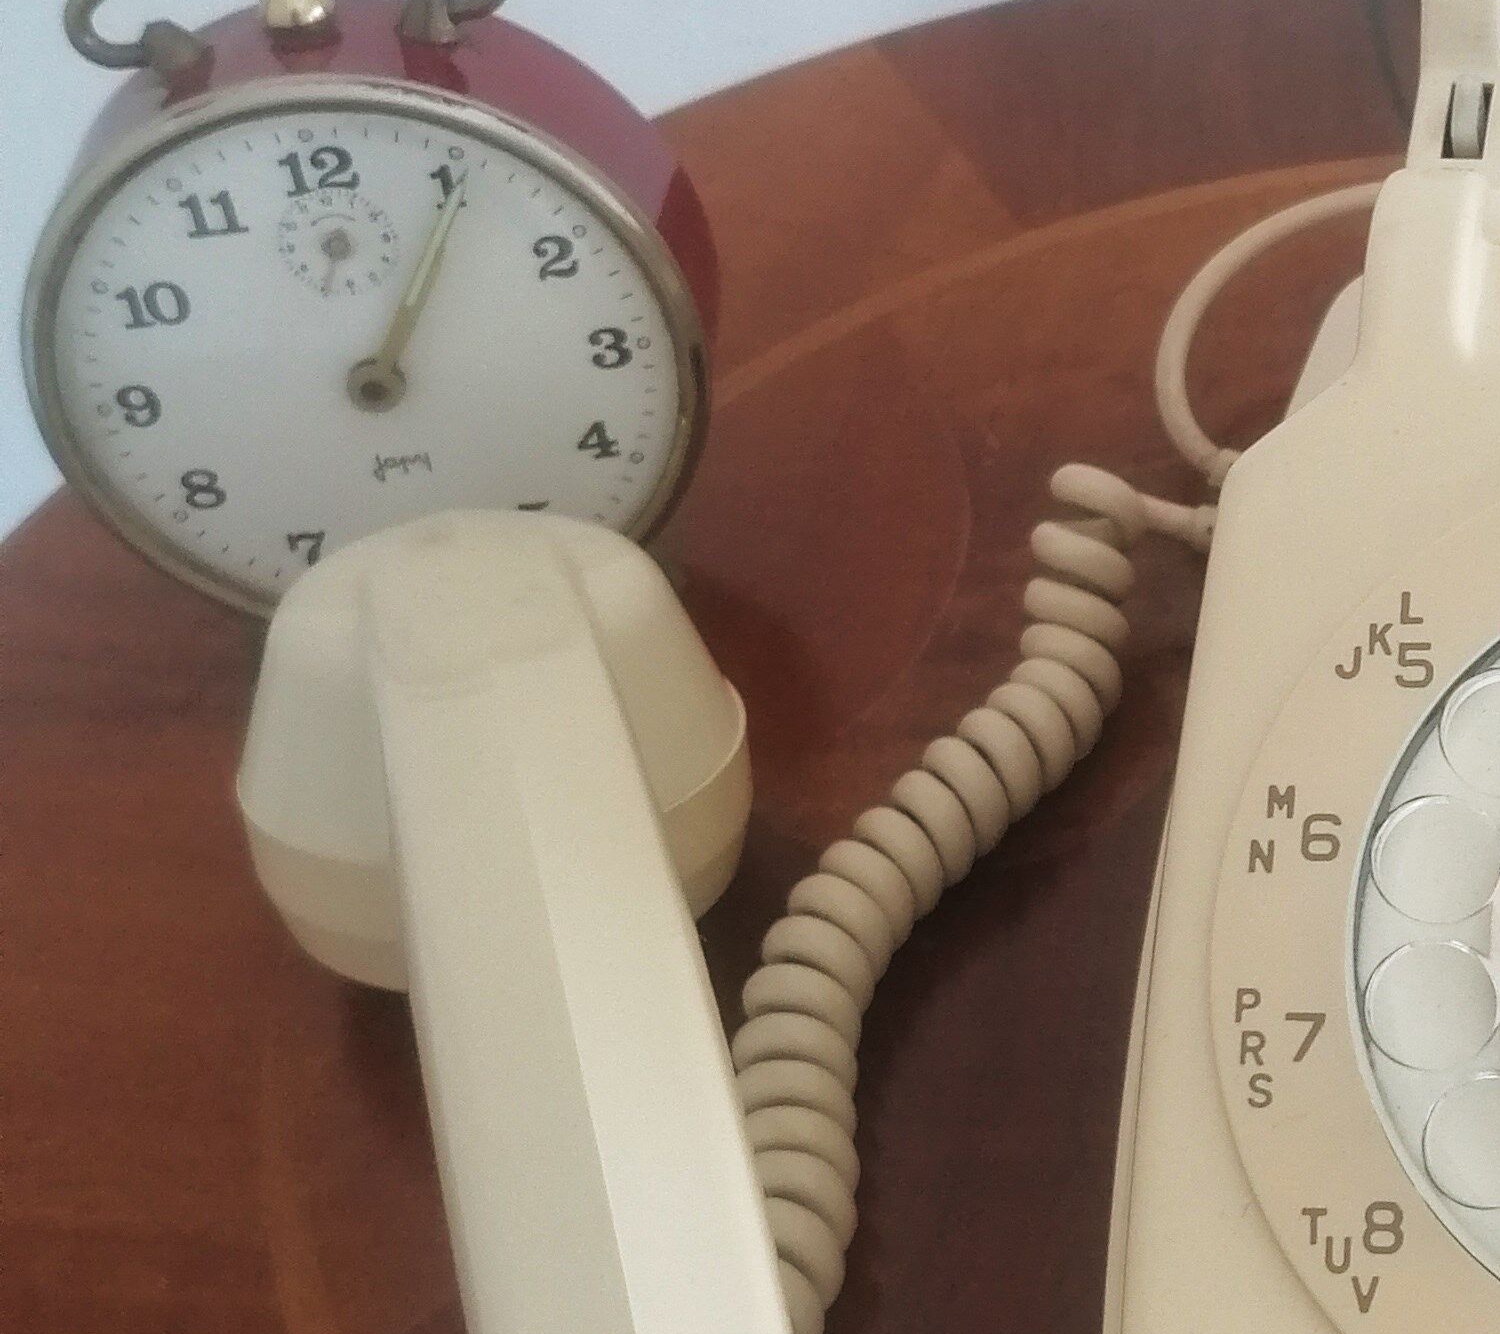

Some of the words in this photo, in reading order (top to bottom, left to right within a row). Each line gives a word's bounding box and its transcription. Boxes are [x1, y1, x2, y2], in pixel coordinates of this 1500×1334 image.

[278, 146, 360, 196] 12
[430, 164, 468, 209] 1
[178, 189, 249, 240] 11
[531, 234, 580, 282] 2
[115, 280, 191, 330] 10
[588, 327, 633, 370] 3
[115, 384, 162, 428] 9
[577, 421, 621, 460] 4
[180, 468, 227, 510] 8
[287, 531, 326, 567] 7
[1394, 641, 1435, 689] 5
[1300, 813, 1342, 862] 6
[1284, 1011, 1327, 1063] 7
[1362, 1200, 1405, 1255] 8
